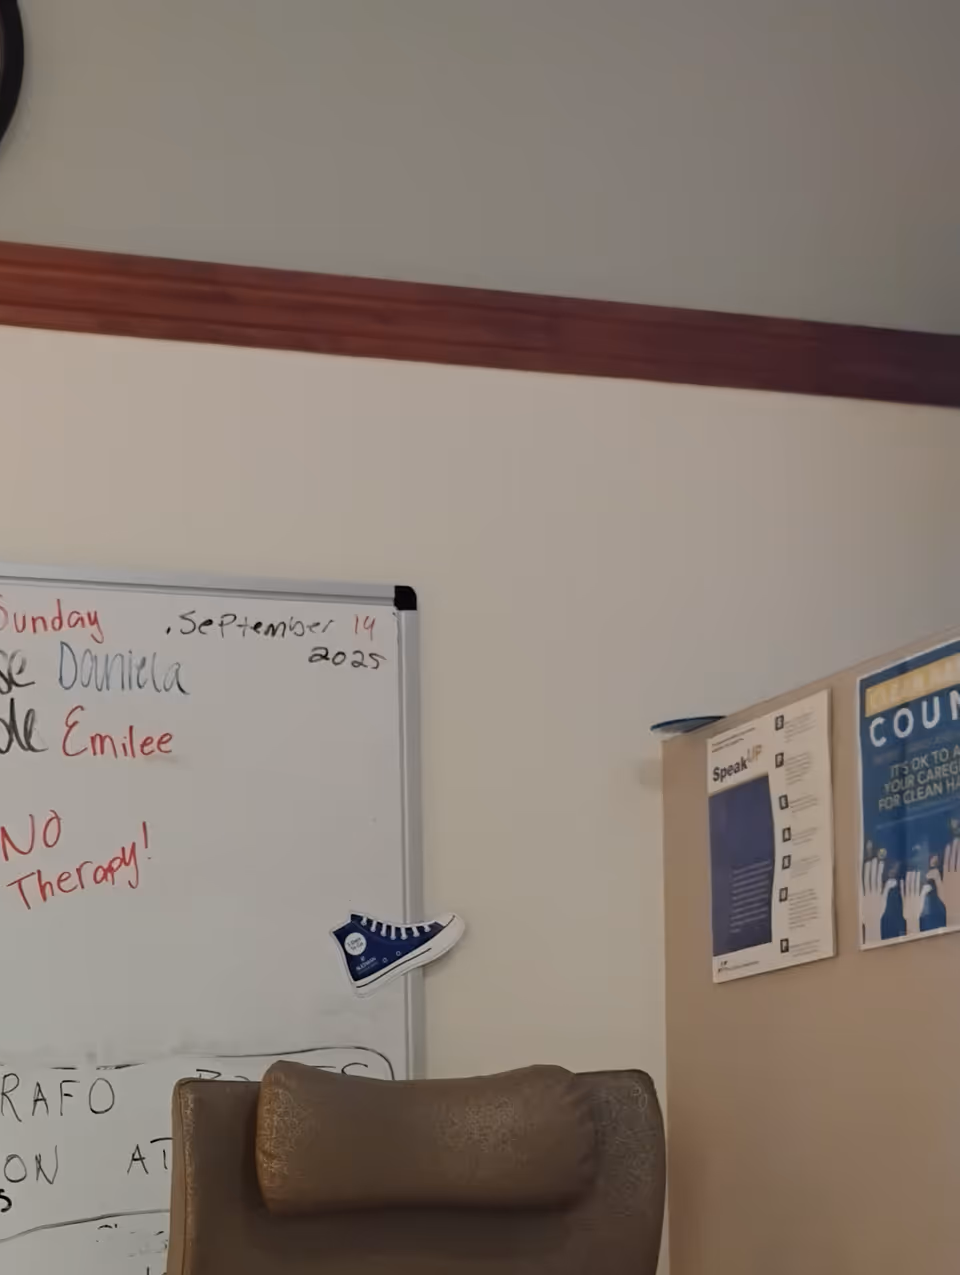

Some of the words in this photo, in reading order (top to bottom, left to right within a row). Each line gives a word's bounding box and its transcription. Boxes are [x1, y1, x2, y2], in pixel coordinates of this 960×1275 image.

[309, 646, 387, 670] 2025
[62, 705, 174, 758] Emilee
[713, 757, 748, 783] Speak
[911, 756, 929, 771] OK
[931, 747, 949, 763] TO
[878, 794, 902, 813] FOR
[903, 783, 943, 805] CLEAN
[884, 773, 915, 796] YOUR
[0, 809, 62, 861] NO
[7, 821, 153, 910] Therapy!
[4, 1145, 58, 1184] ON
